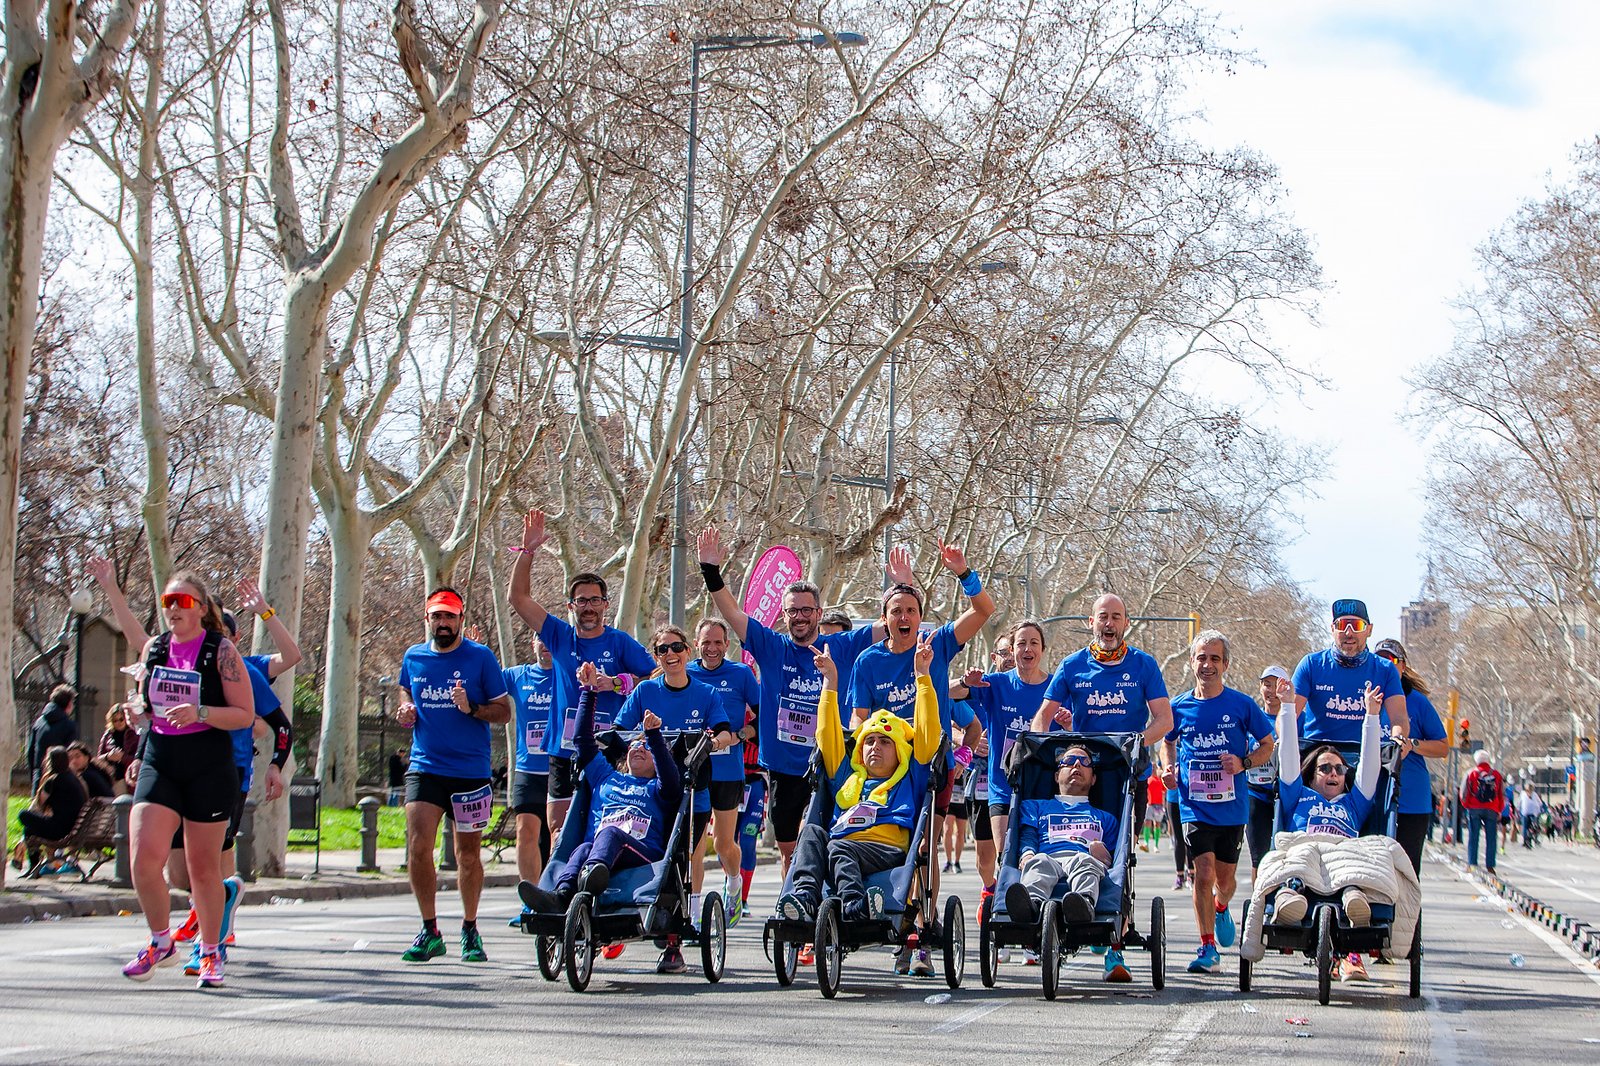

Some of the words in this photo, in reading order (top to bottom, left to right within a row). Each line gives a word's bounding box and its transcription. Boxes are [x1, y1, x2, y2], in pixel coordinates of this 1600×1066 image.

[752, 560, 793, 624] aefat
[156, 681, 192, 696] MELWYN
[788, 711, 812, 725] MARC
[1200, 772, 1224, 782] ORIOL
[462, 801, 482, 813] FRAN
